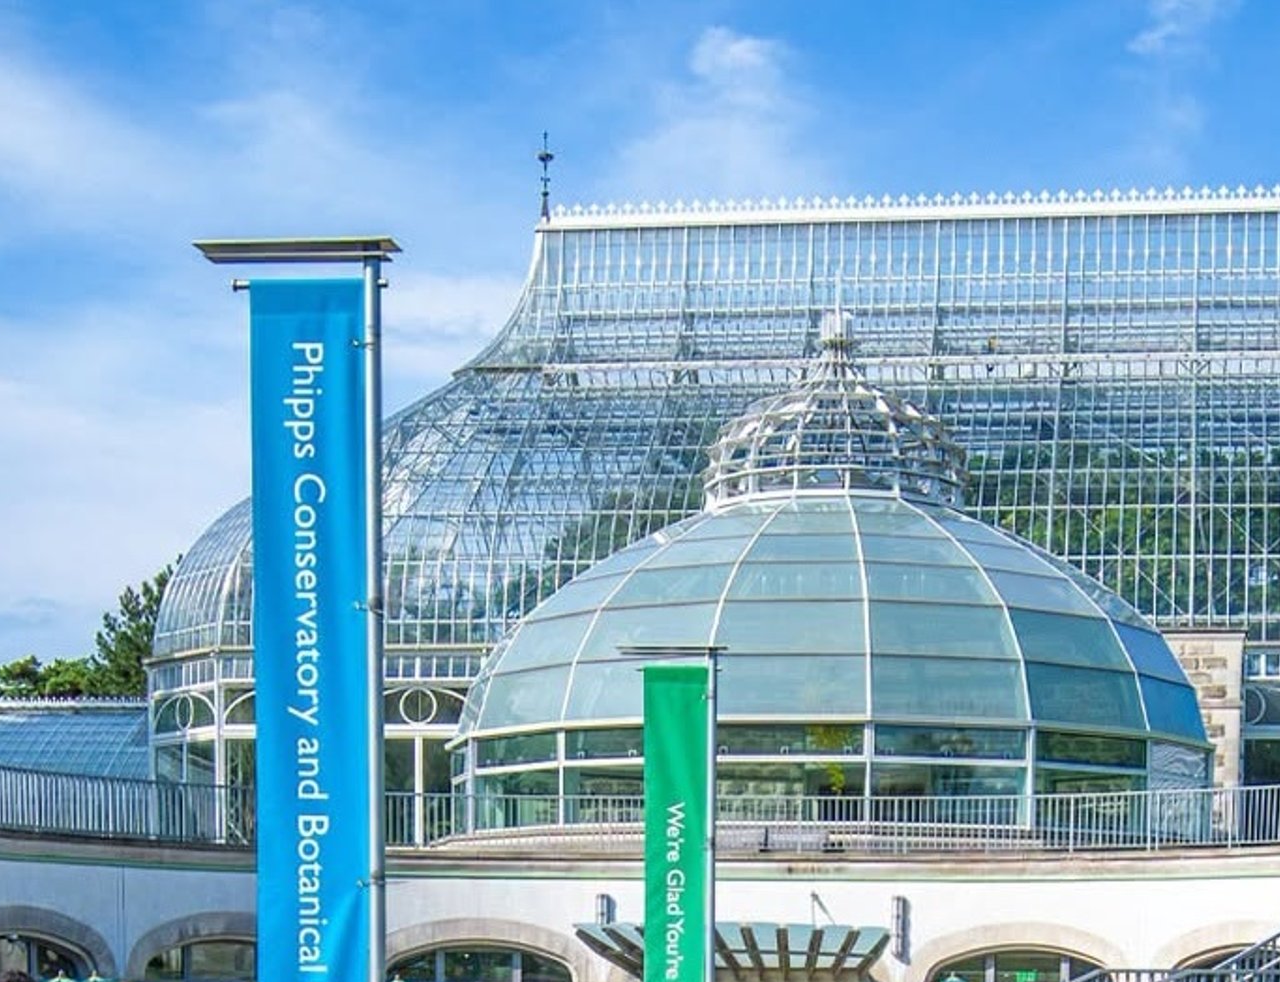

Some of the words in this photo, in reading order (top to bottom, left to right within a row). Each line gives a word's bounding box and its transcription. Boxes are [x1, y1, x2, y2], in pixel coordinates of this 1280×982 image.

[284, 341, 324, 458] Phipps
[288, 473, 326, 725] Conservatory
[297, 737, 328, 799] and
[665, 801, 685, 862] We're
[298, 815, 329, 973] Botanical
[665, 869, 685, 916] Glad
[665, 917, 684, 980] You're
